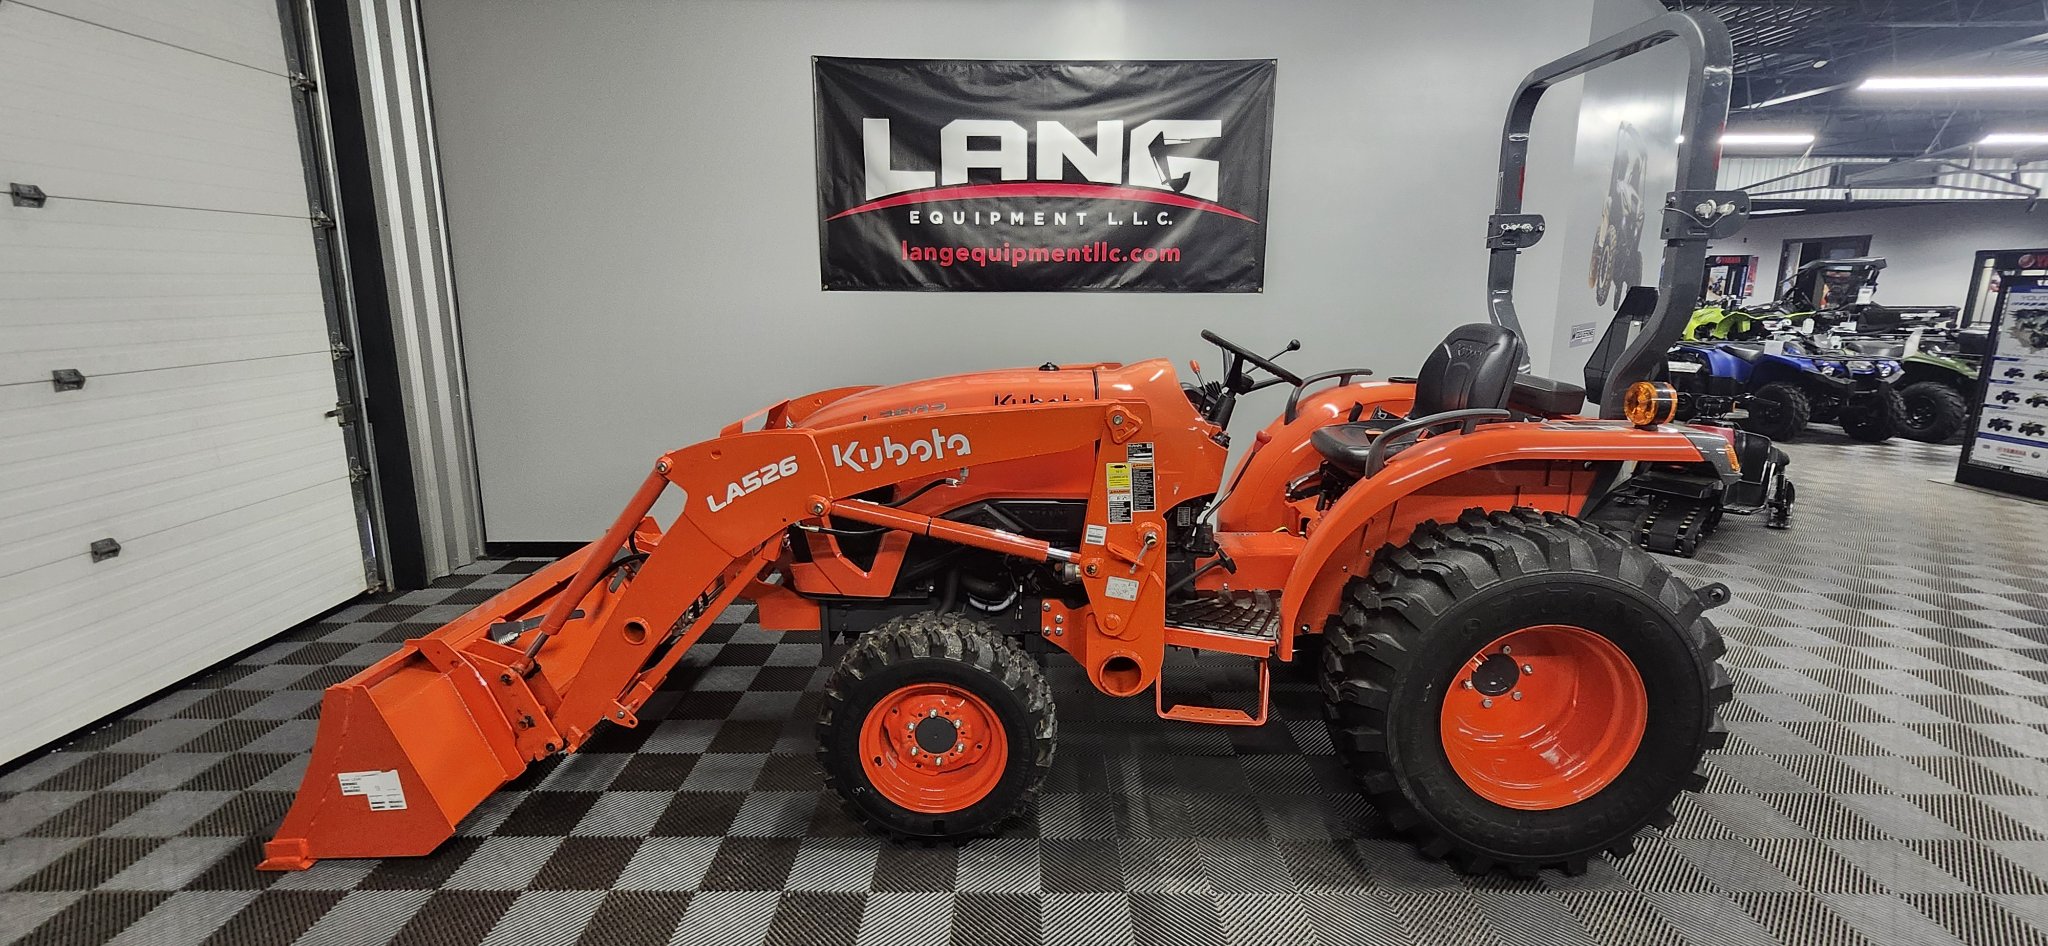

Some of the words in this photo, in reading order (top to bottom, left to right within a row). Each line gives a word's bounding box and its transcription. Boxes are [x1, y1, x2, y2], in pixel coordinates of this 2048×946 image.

[862, 117, 1222, 202] LANG
[909, 210, 1088, 227] EQUIPMENT
[901, 240, 1181, 267] langequipmentllc.com
[832, 428, 972, 473] Kubota
[706, 455, 800, 513] LA526
